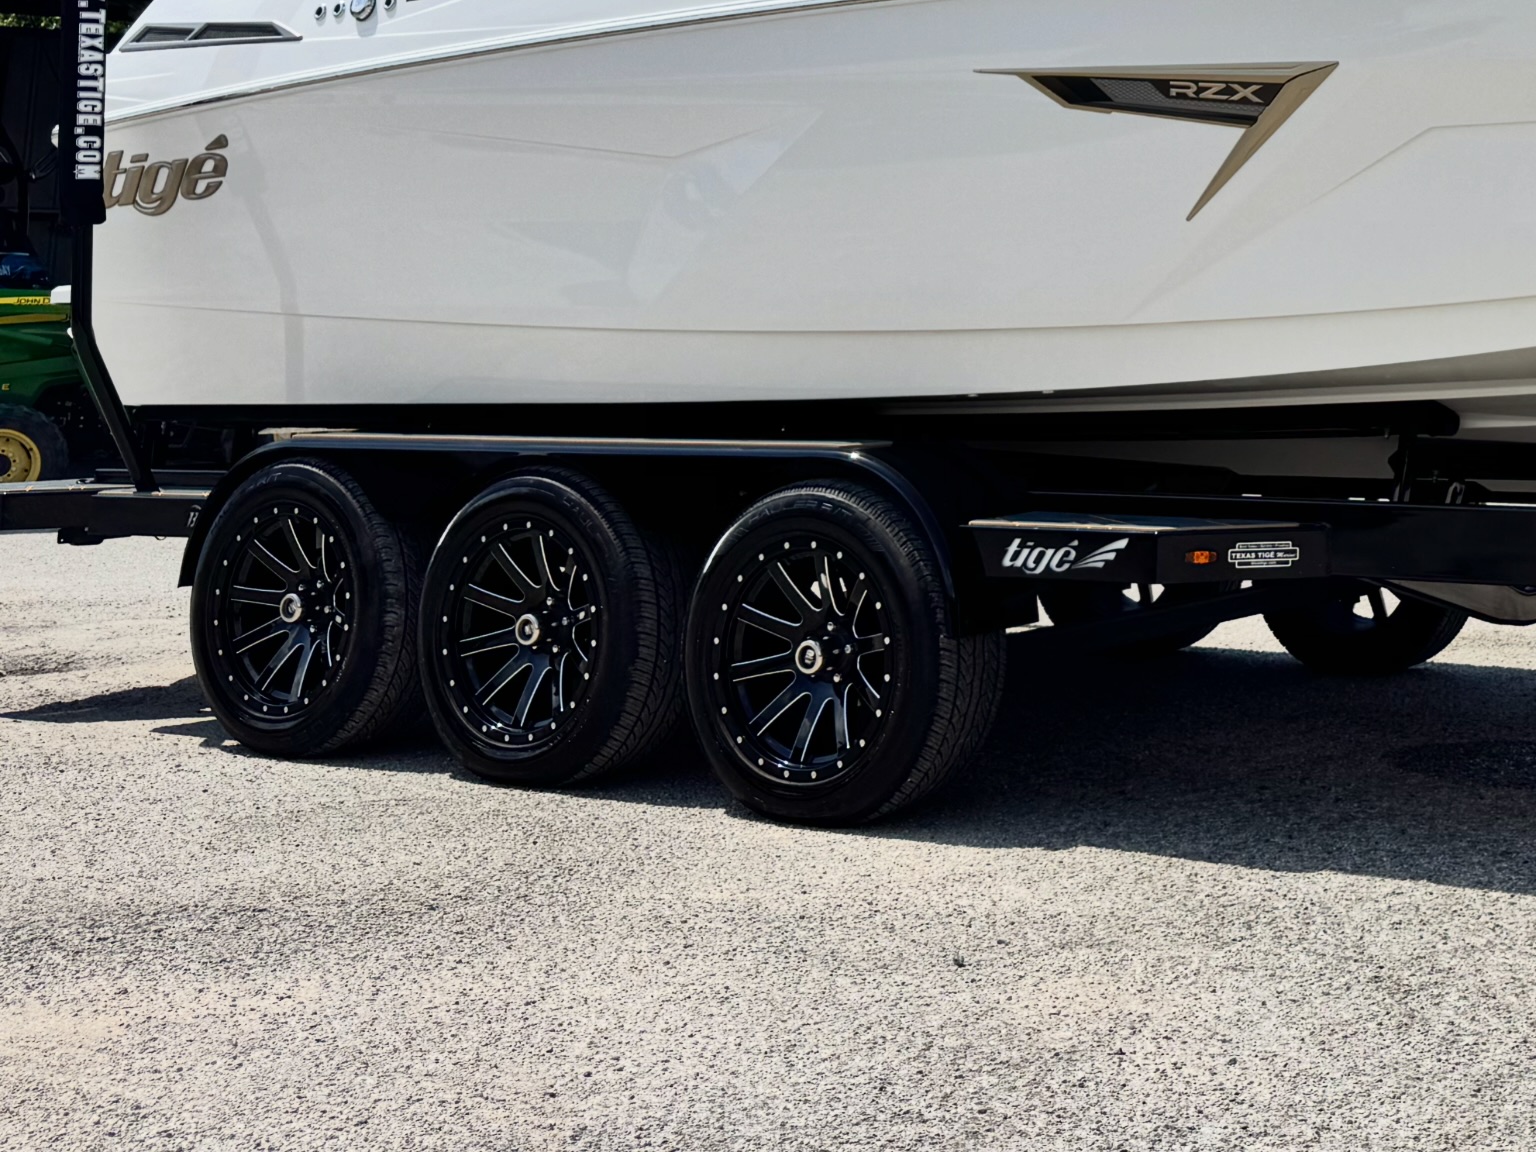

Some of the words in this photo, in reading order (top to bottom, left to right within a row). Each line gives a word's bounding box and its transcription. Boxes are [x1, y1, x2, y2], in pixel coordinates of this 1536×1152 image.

[1169, 81, 1265, 104] RZX
[103, 134, 229, 216] tigé
[15, 297, 41, 305] JOHN
[1001, 537, 1079, 575] tigé
